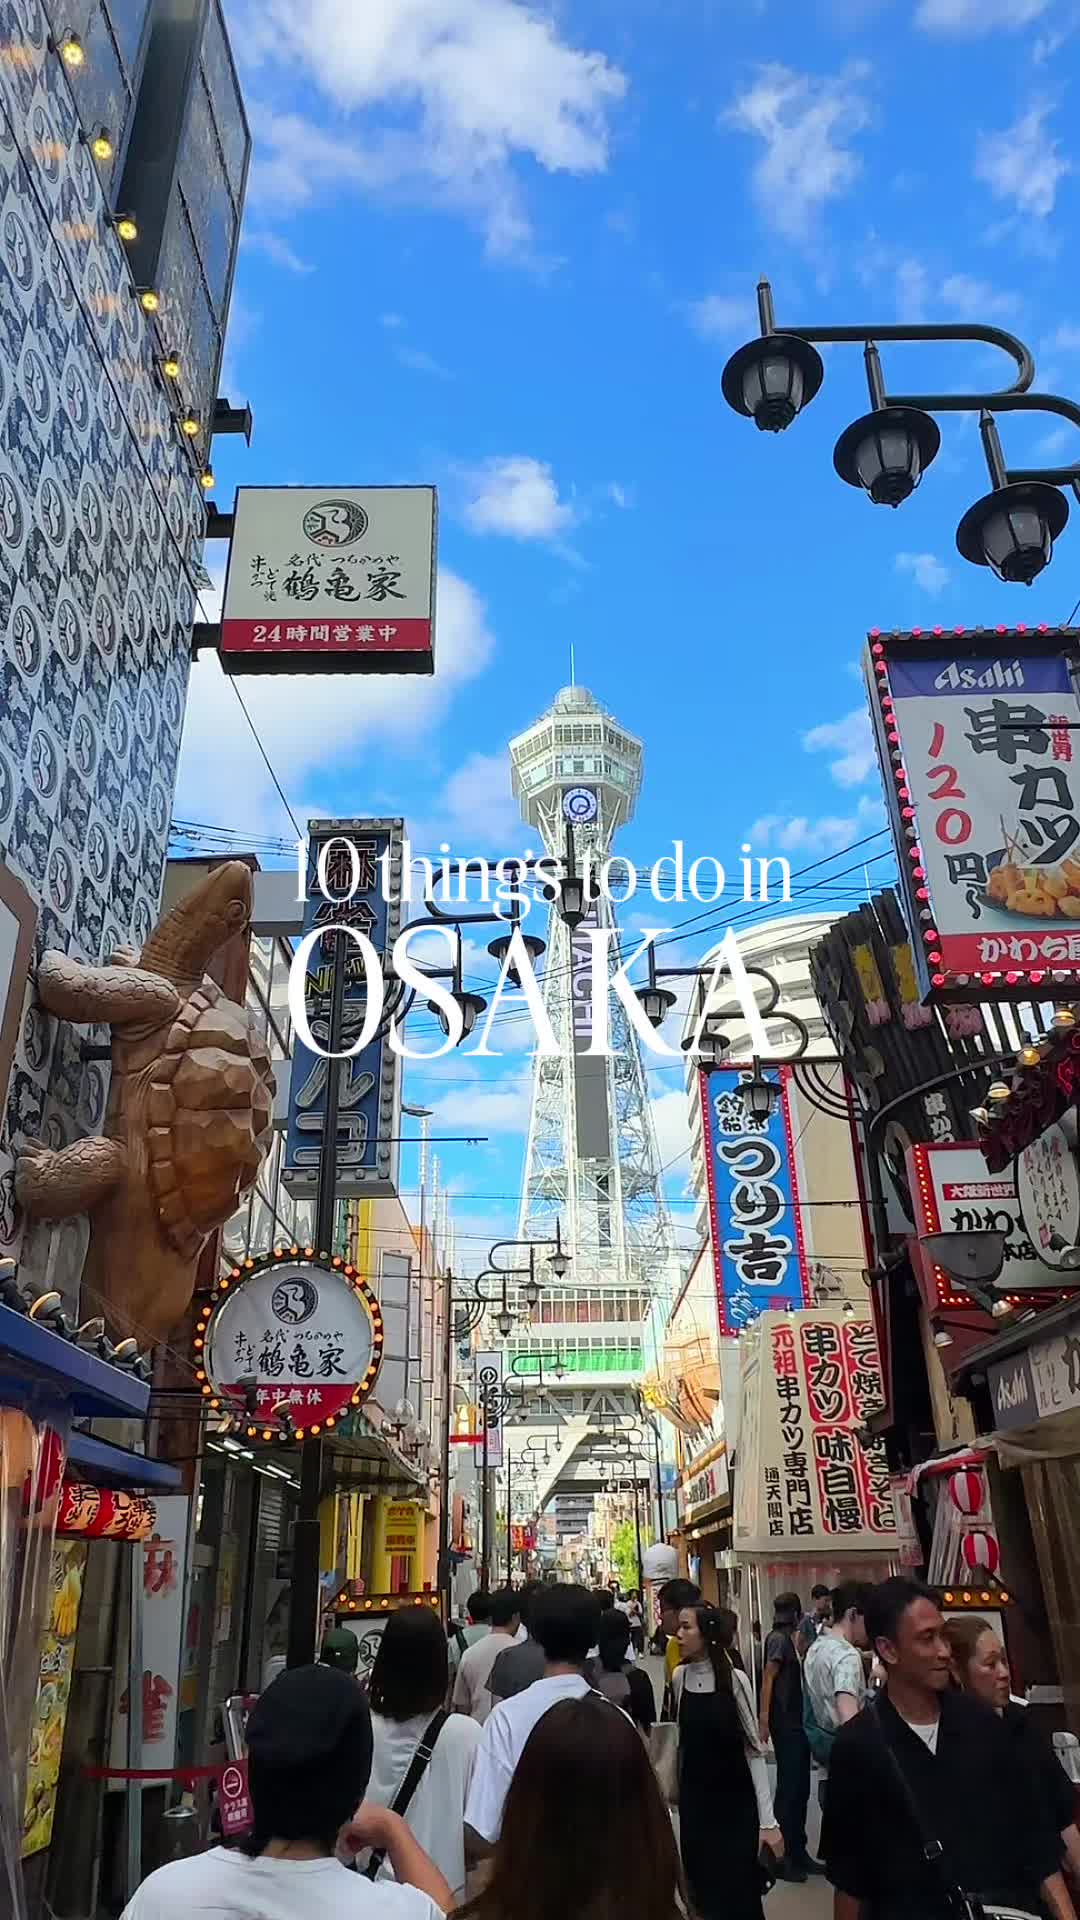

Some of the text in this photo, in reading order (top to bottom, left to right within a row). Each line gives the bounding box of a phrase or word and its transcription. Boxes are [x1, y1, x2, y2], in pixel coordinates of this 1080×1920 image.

[283, 565, 407, 602] 鶴亀家
[252, 624, 398, 643] 24時間営業中
[934, 659, 1025, 690] Asahi
[963, 698, 1080, 866] 串カツ
[719, 1138, 791, 1284] つり吉
[803, 1325, 845, 1421] 串カツ
[771, 1323, 815, 1536] 元祖串カツ専門店
